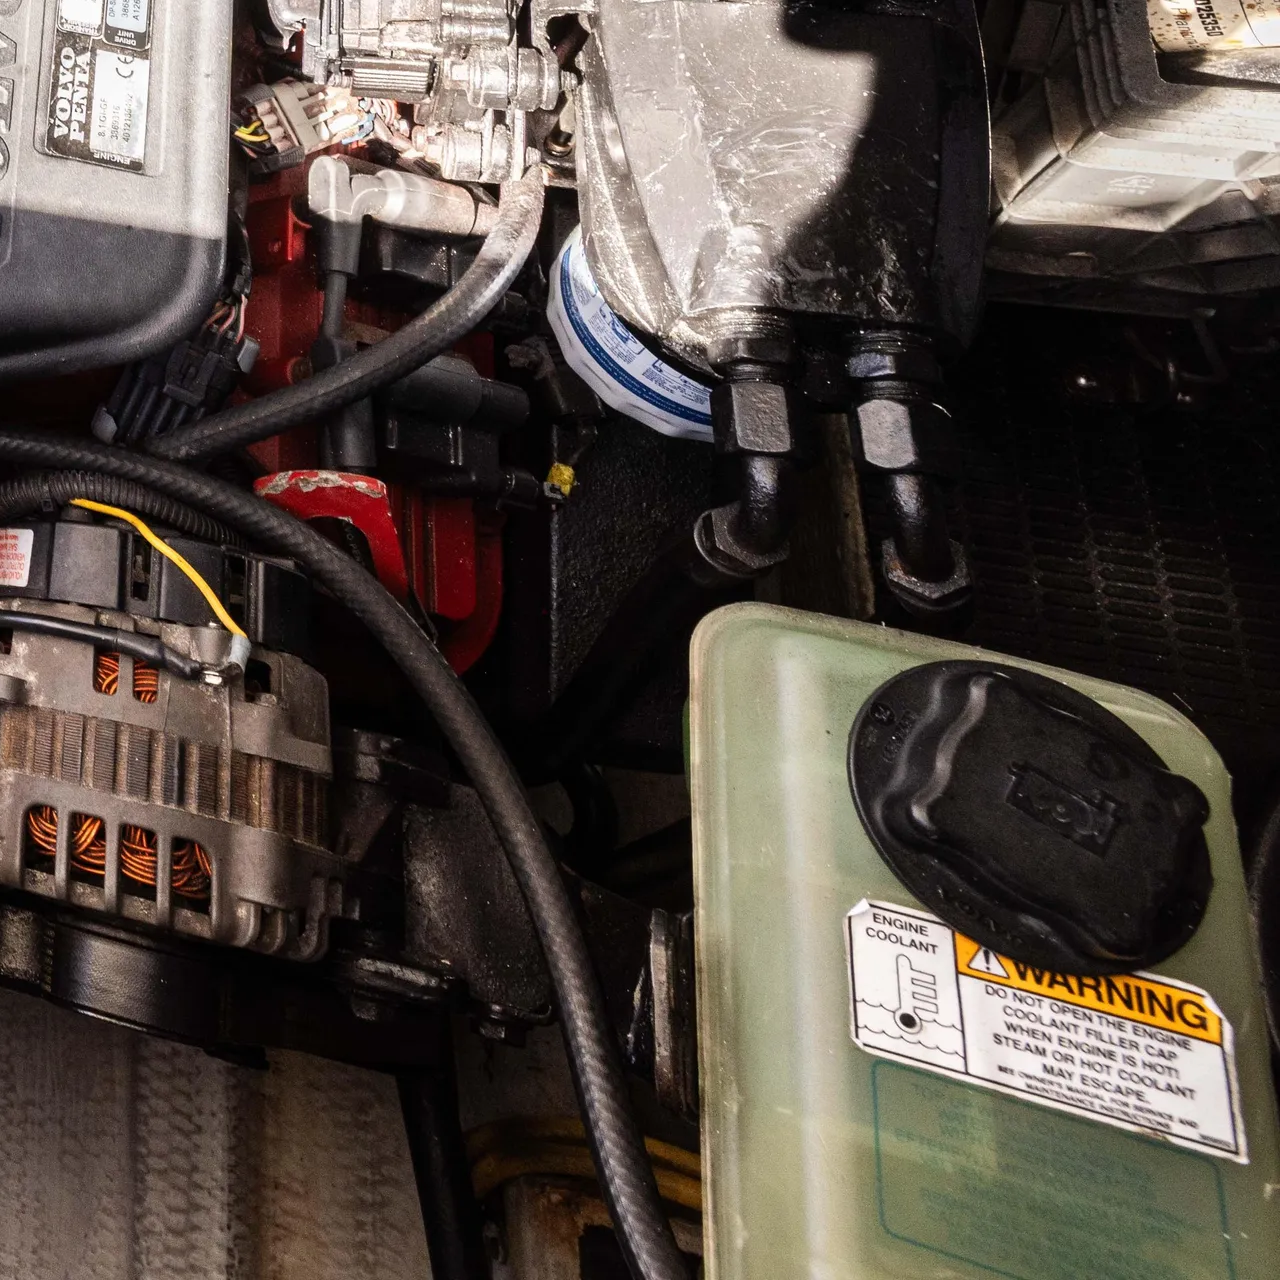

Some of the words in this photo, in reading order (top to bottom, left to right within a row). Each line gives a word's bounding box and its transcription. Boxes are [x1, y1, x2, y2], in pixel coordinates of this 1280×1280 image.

[114, 36, 136, 46] DRIVE
[117, 30, 134, 38] UNIT
[54, 47, 75, 138] VOLVO
[70, 52, 90, 143] PENTA
[93, 151, 131, 165] ENGINE
[865, 927, 938, 954] COOLANT
[873, 913, 929, 937] ENGINE
[985, 984, 1008, 1000] DO
[1012, 990, 1043, 1010] NOT
[1050, 1002, 1096, 1024] OPEN
[1098, 1014, 1126, 1032] THE
[1132, 1023, 1192, 1051] ENGINE
[1012, 961, 1210, 1032] WARNING
[1002, 1005, 1080, 1035] COOLANT
[1084, 1027, 1139, 1053] FILLER
[1144, 1044, 1178, 1062] CAP
[1004, 1021, 1052, 1044] WHEN
[1058, 1036, 1116, 1062] ENGINE
[1122, 1054, 1137, 1068] IS
[1142, 1060, 1180, 1080] HOT!
[993, 1033, 1047, 1058] STEAM
[1052, 1050, 1076, 1066] OR
[1080, 1056, 1112, 1076] HOT
[1118, 1068, 1196, 1100] COOLANT
[1042, 1064, 1075, 1082] MAY
[1080, 1076, 1151, 1104] ESCAPE.
[998, 1065, 1015, 1076] SEE
[1018, 1071, 1062, 1089] OWNER'S
[1067, 1084, 1106, 1103] MANUAL
[1116, 1097, 1132, 1109] FOR
[1134, 1101, 1174, 1121] SERVICE
[1179, 1115, 1199, 1129] AND
[1025, 1081, 1096, 1109] MAINTENANCE
[1099, 1104, 1171, 1132] INSTRUCTIONS
